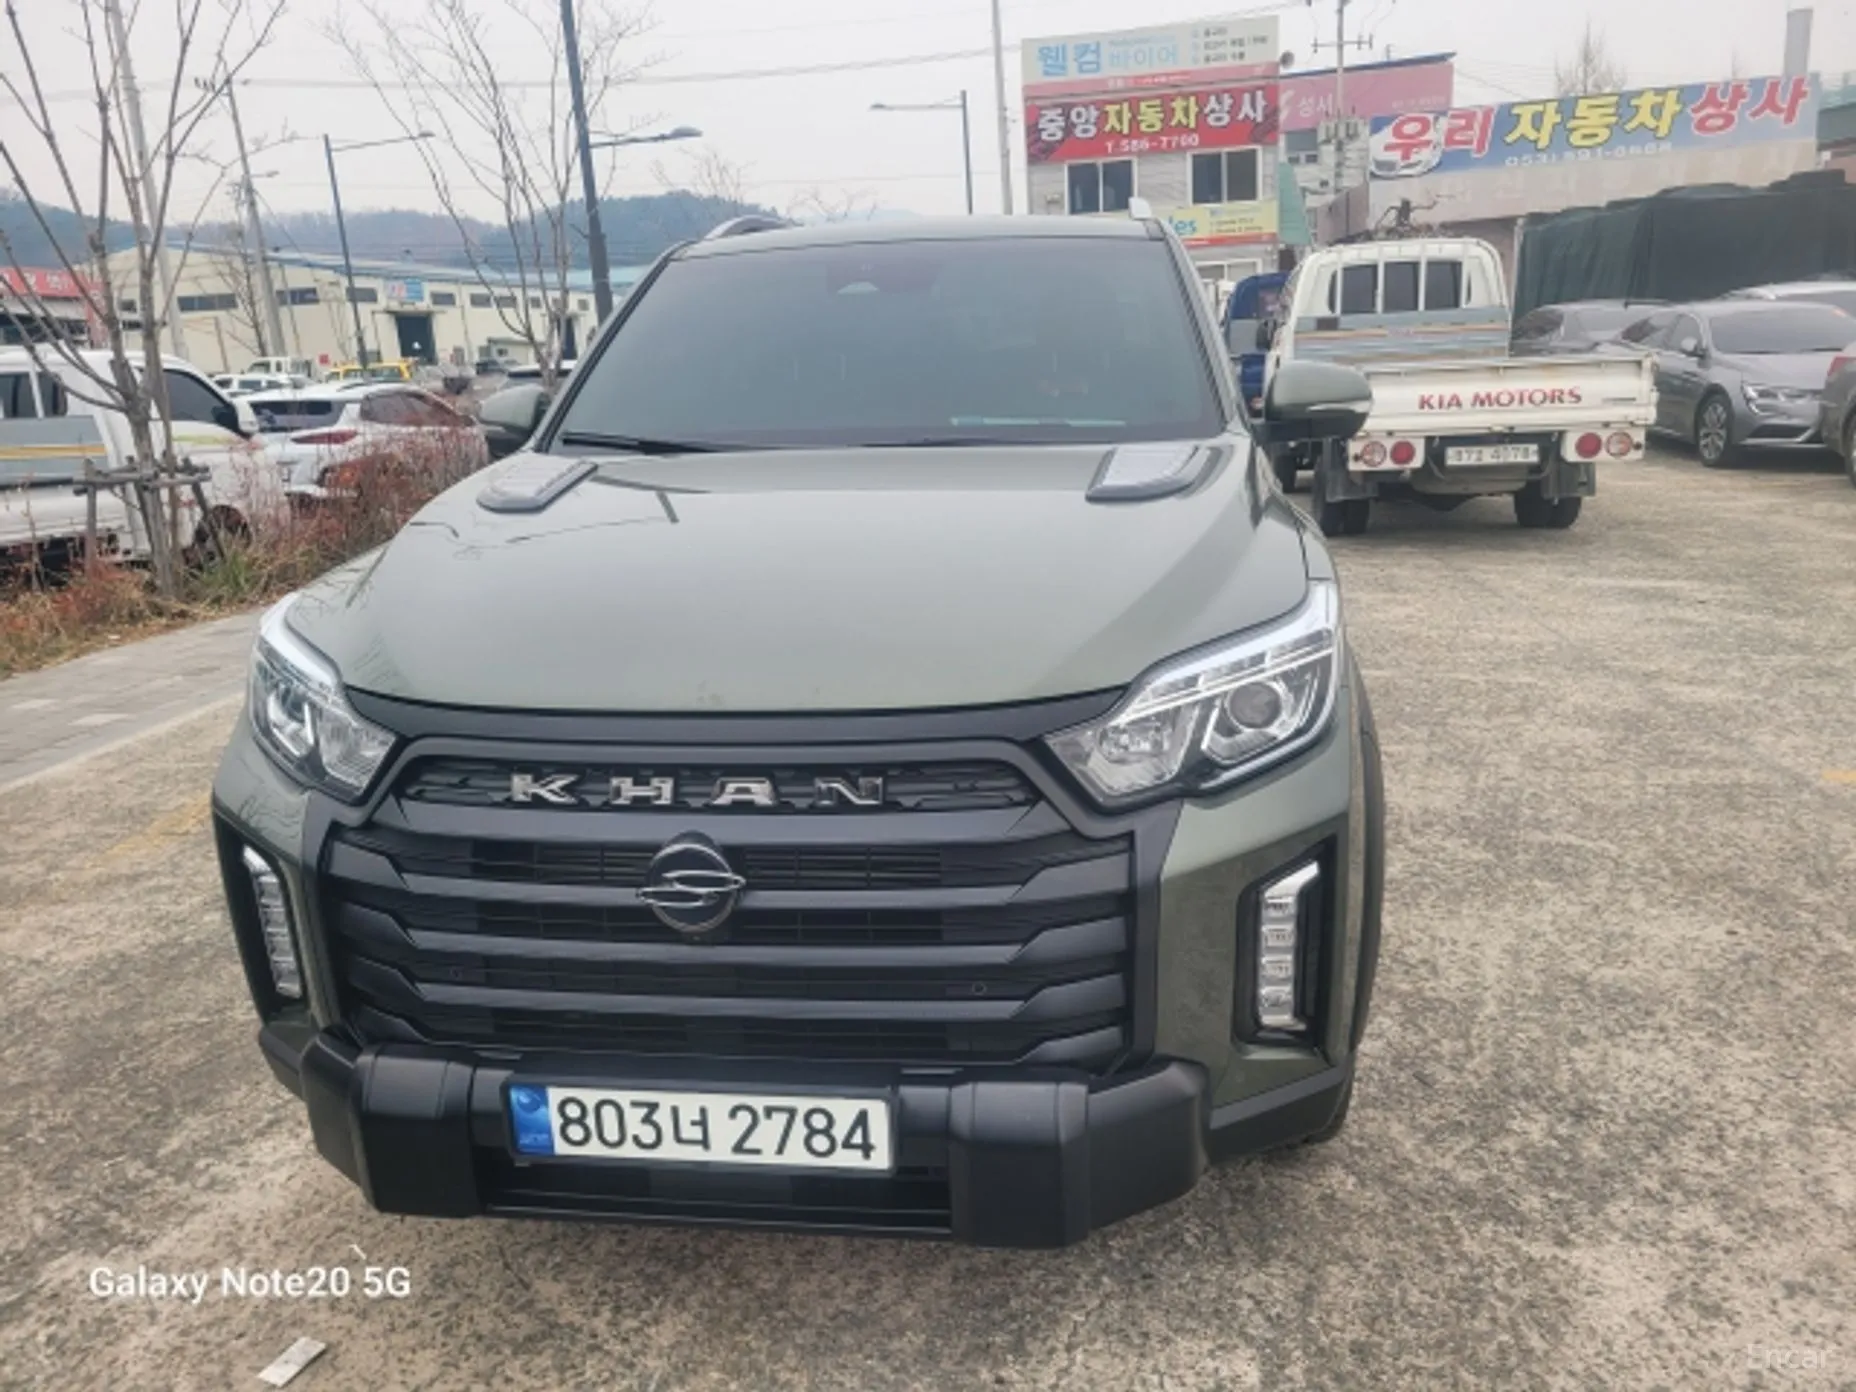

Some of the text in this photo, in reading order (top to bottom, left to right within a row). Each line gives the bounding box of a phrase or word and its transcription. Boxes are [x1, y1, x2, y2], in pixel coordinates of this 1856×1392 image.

[1038, 41, 1101, 77] 웰컴
[1038, 89, 1267, 141] 중앙자동차상사
[1418, 386, 1582, 410] KIA MOTORS
[509, 772, 883, 807] KHAN
[557, 1096, 876, 1160] 803너 2784
